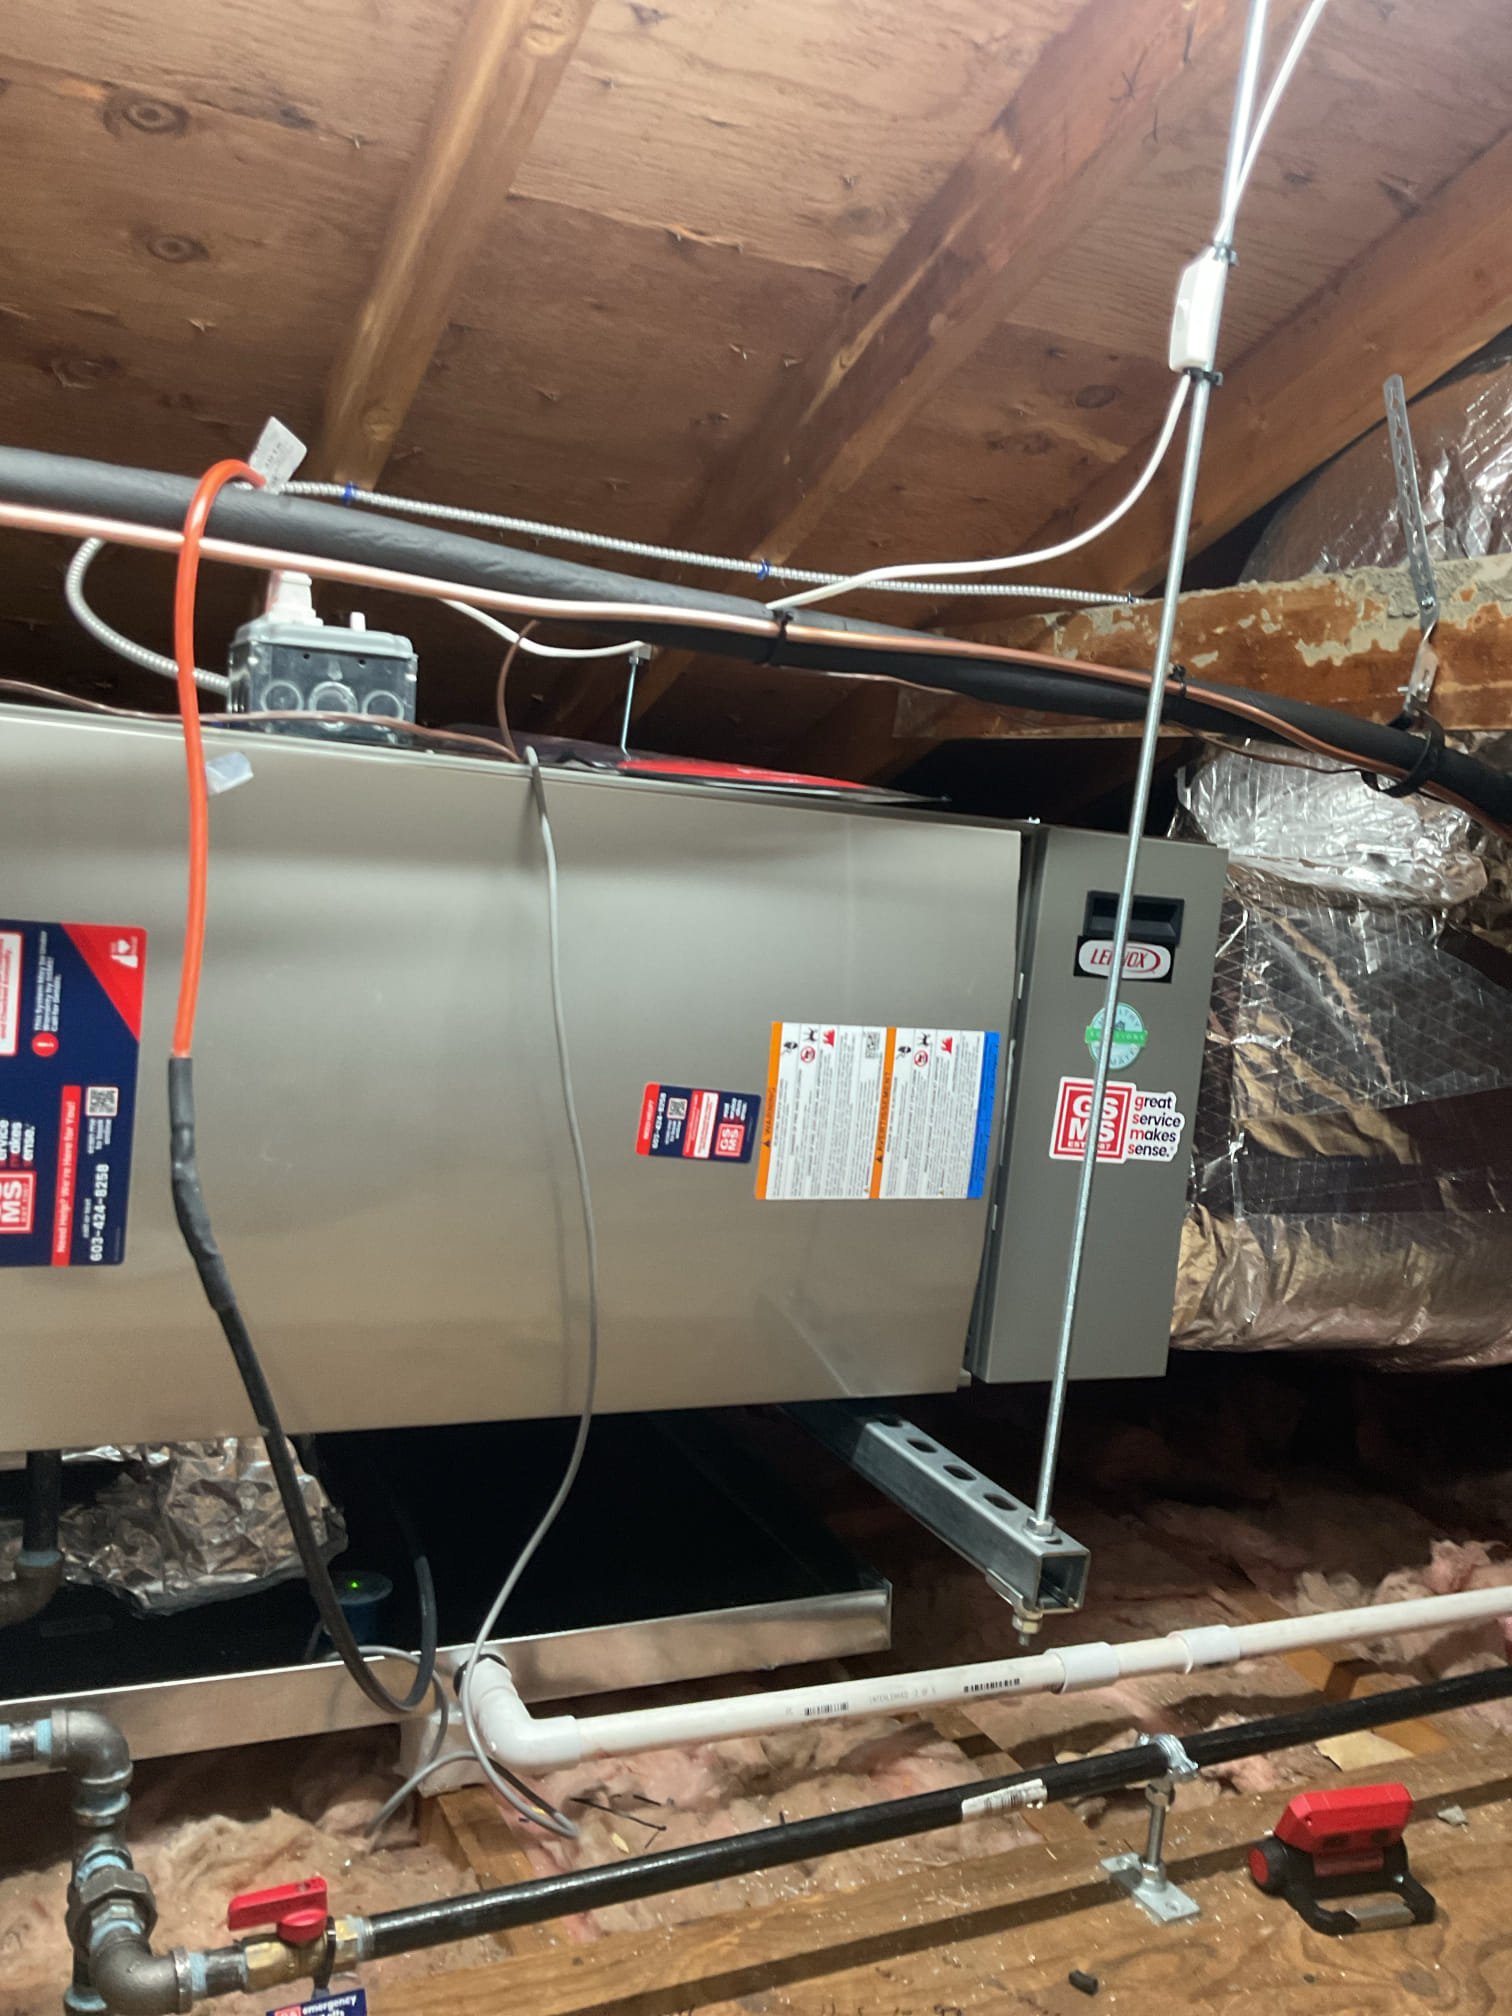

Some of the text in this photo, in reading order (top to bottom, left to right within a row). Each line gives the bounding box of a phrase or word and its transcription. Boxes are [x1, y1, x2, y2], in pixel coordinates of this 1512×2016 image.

[1090, 948, 1148, 969] LEOX
[1073, 1095, 1119, 1120] GS
[1134, 1094, 1173, 1111] great
[1068, 1117, 1115, 1143] MS
[1132, 1112, 1181, 1128] service
[1129, 1127, 1177, 1143] makes
[62, 1142, 74, 1166] Here
[2, 1180, 22, 1223] MS
[57, 1198, 71, 1227] Help?
[55, 1226, 68, 1254] Need
[302, 1994, 358, 2015] emergency
